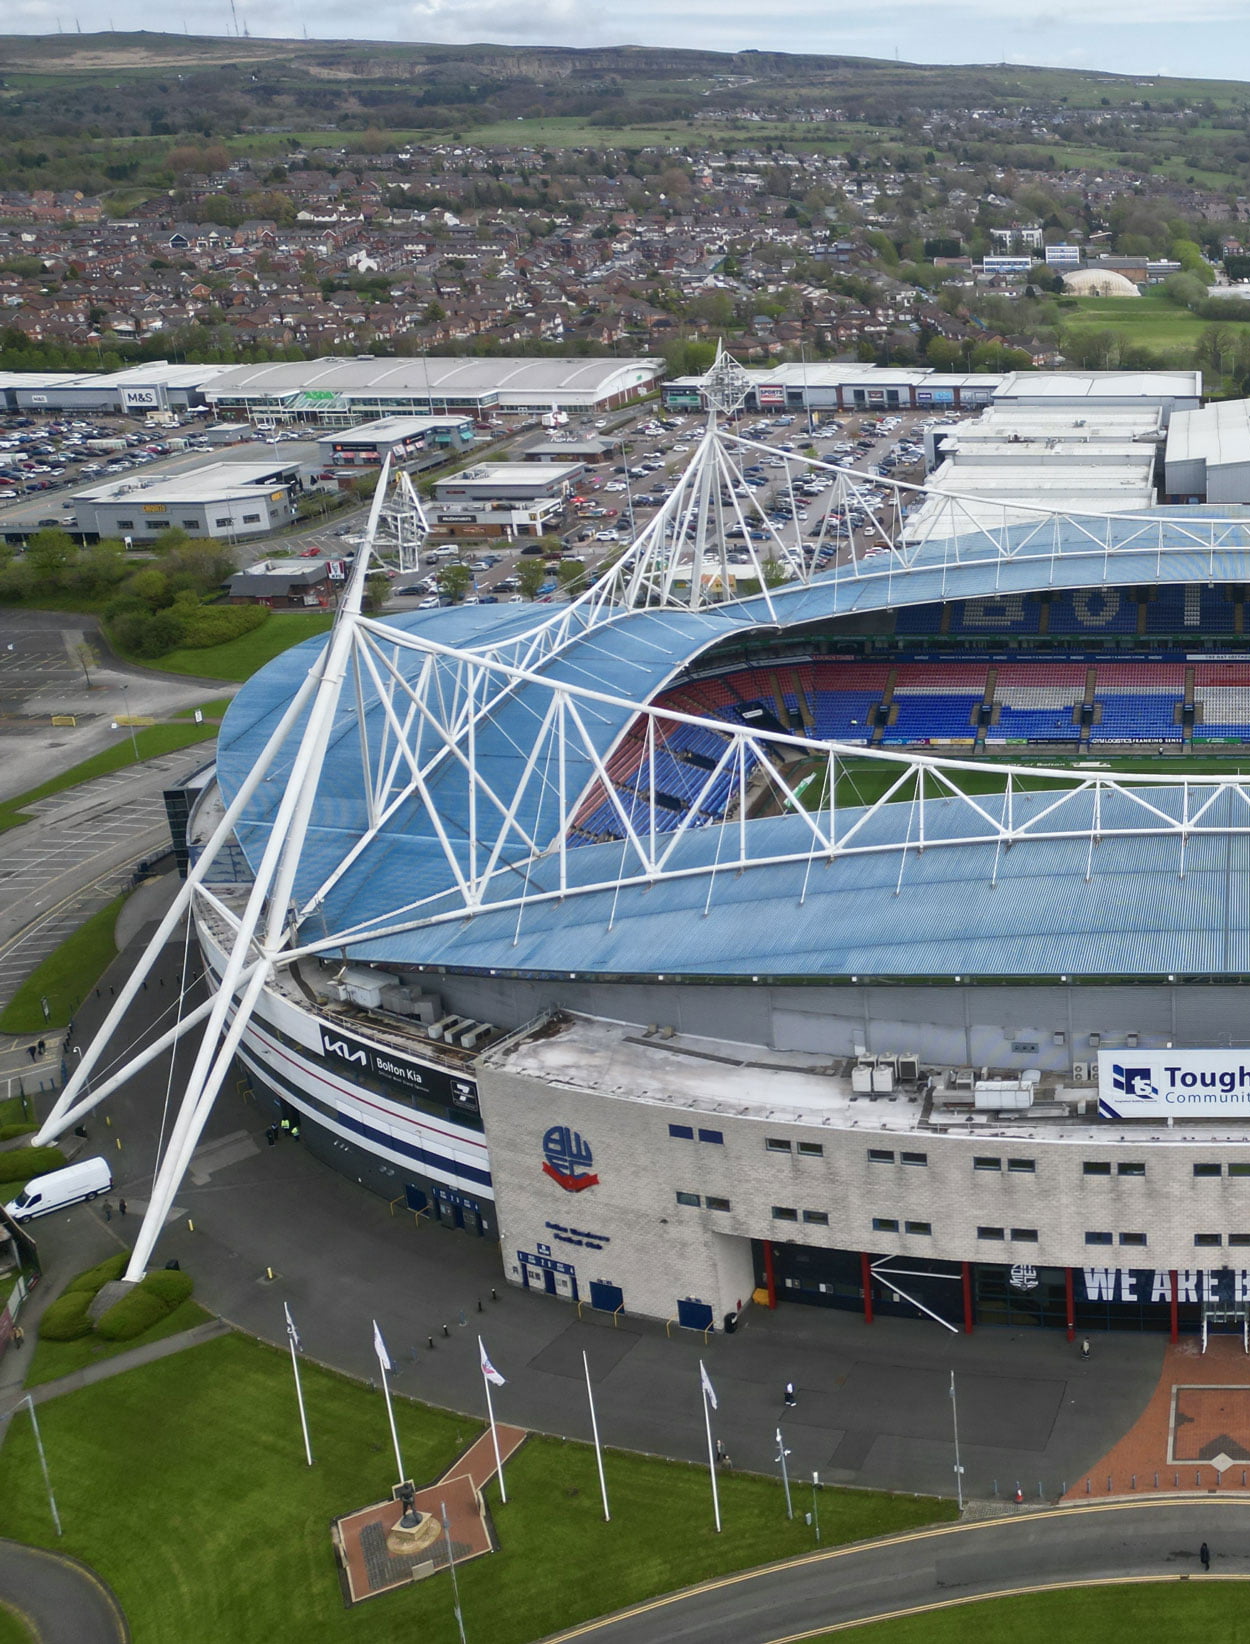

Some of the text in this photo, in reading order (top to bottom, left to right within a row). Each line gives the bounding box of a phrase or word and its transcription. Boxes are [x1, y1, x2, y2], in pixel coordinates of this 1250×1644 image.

[127, 393, 153, 403] M&S
[304, 391, 335, 400] ASDA
[376, 1057, 422, 1083] Bolton Kia
[1083, 1267, 1138, 1301] WE
[1151, 1269, 1219, 1302] ARE
